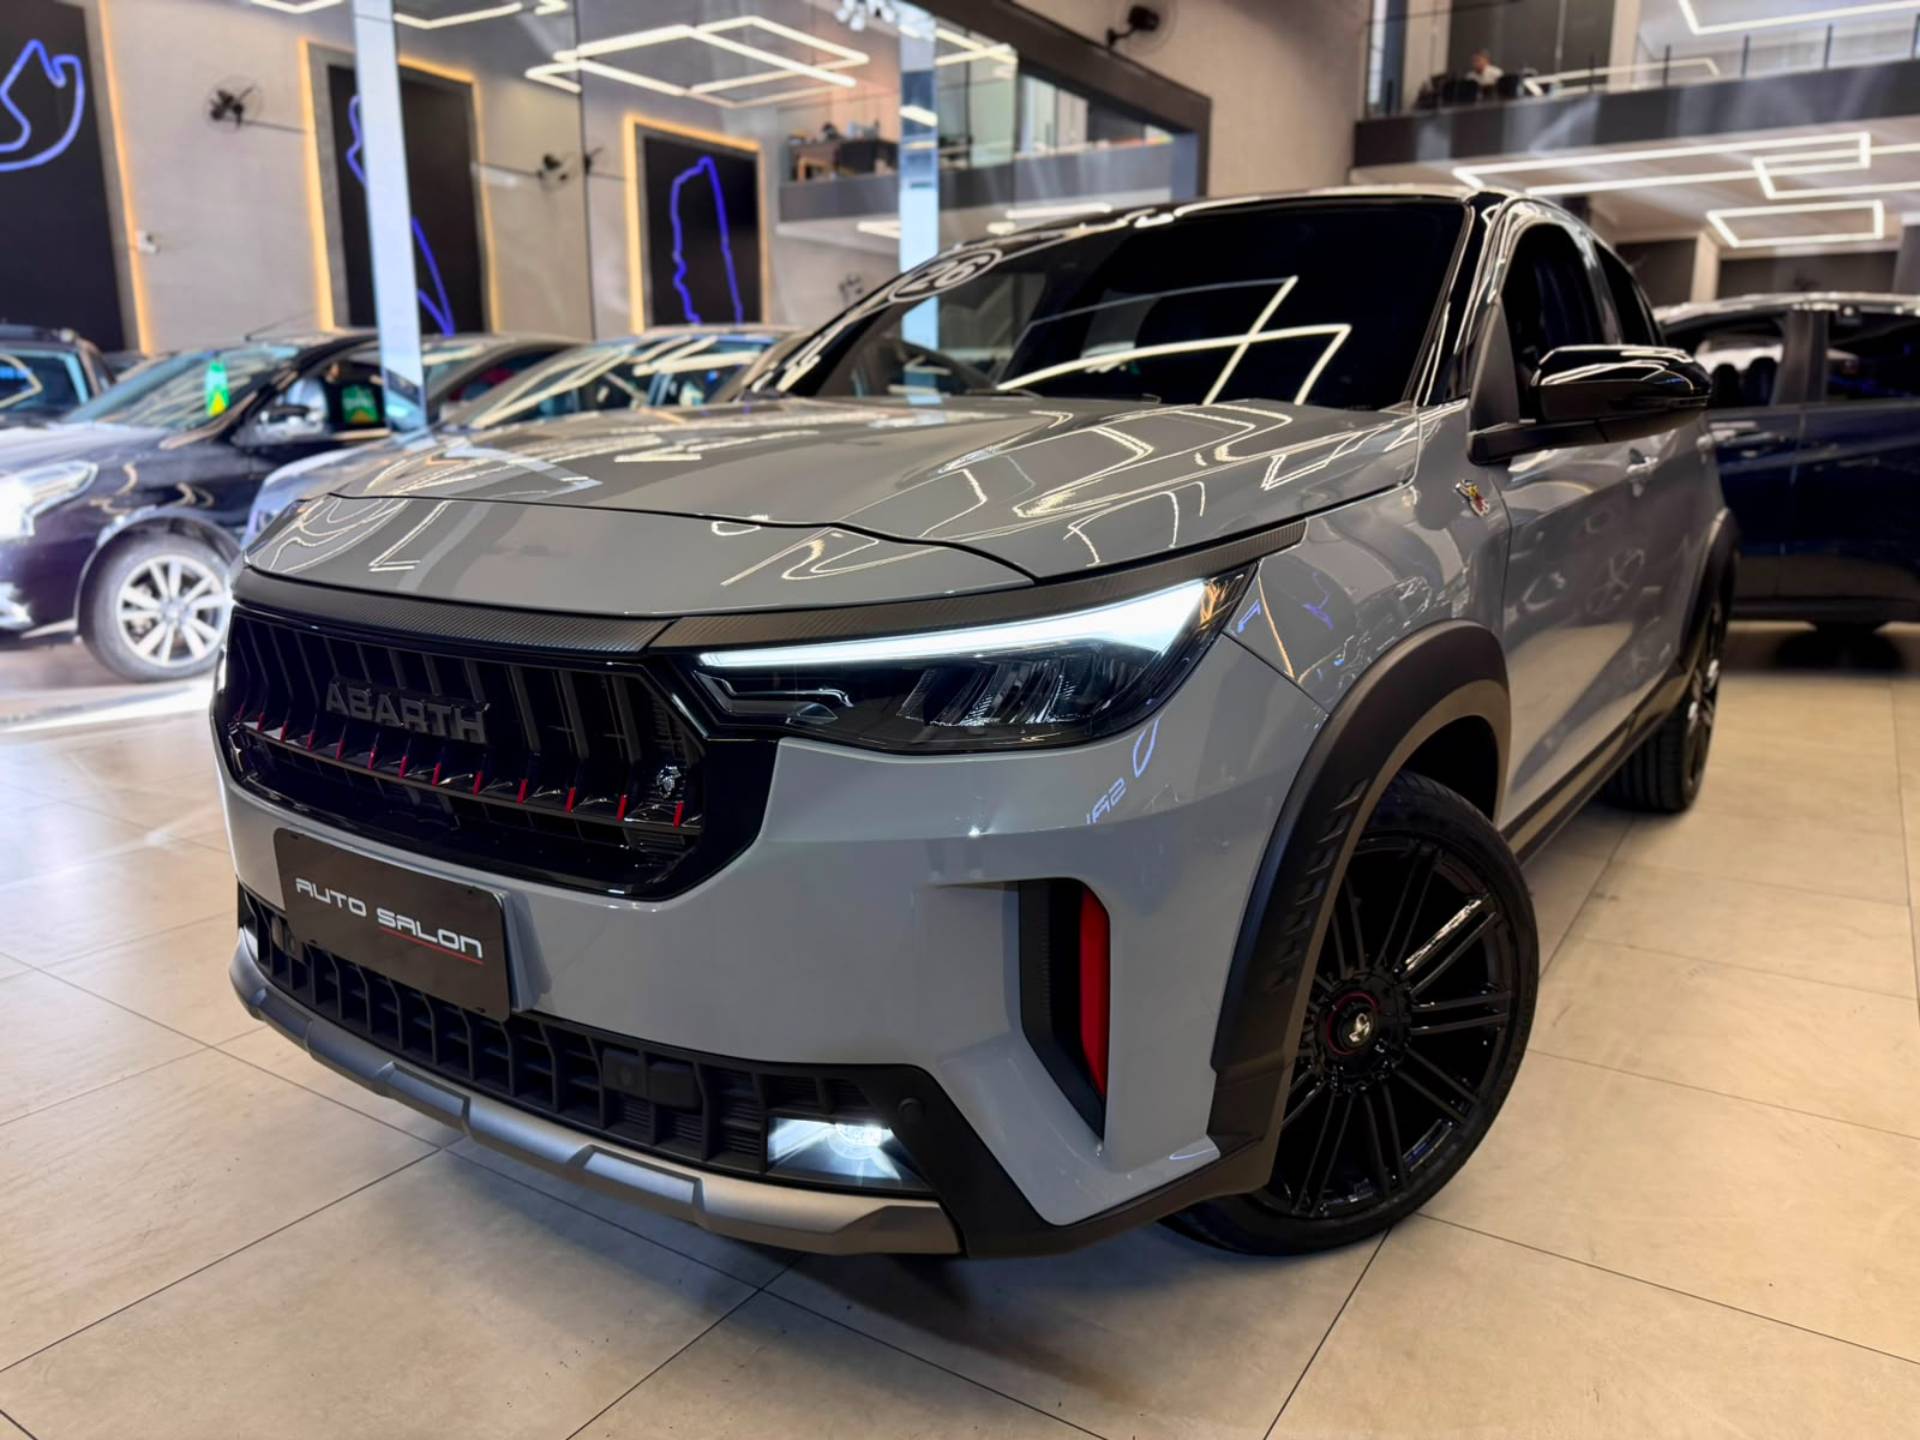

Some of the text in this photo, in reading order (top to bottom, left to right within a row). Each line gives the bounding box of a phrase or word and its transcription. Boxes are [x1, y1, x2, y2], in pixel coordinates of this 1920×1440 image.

[326, 682, 487, 744] ABARTH
[296, 878, 484, 958] AUTO SALON
